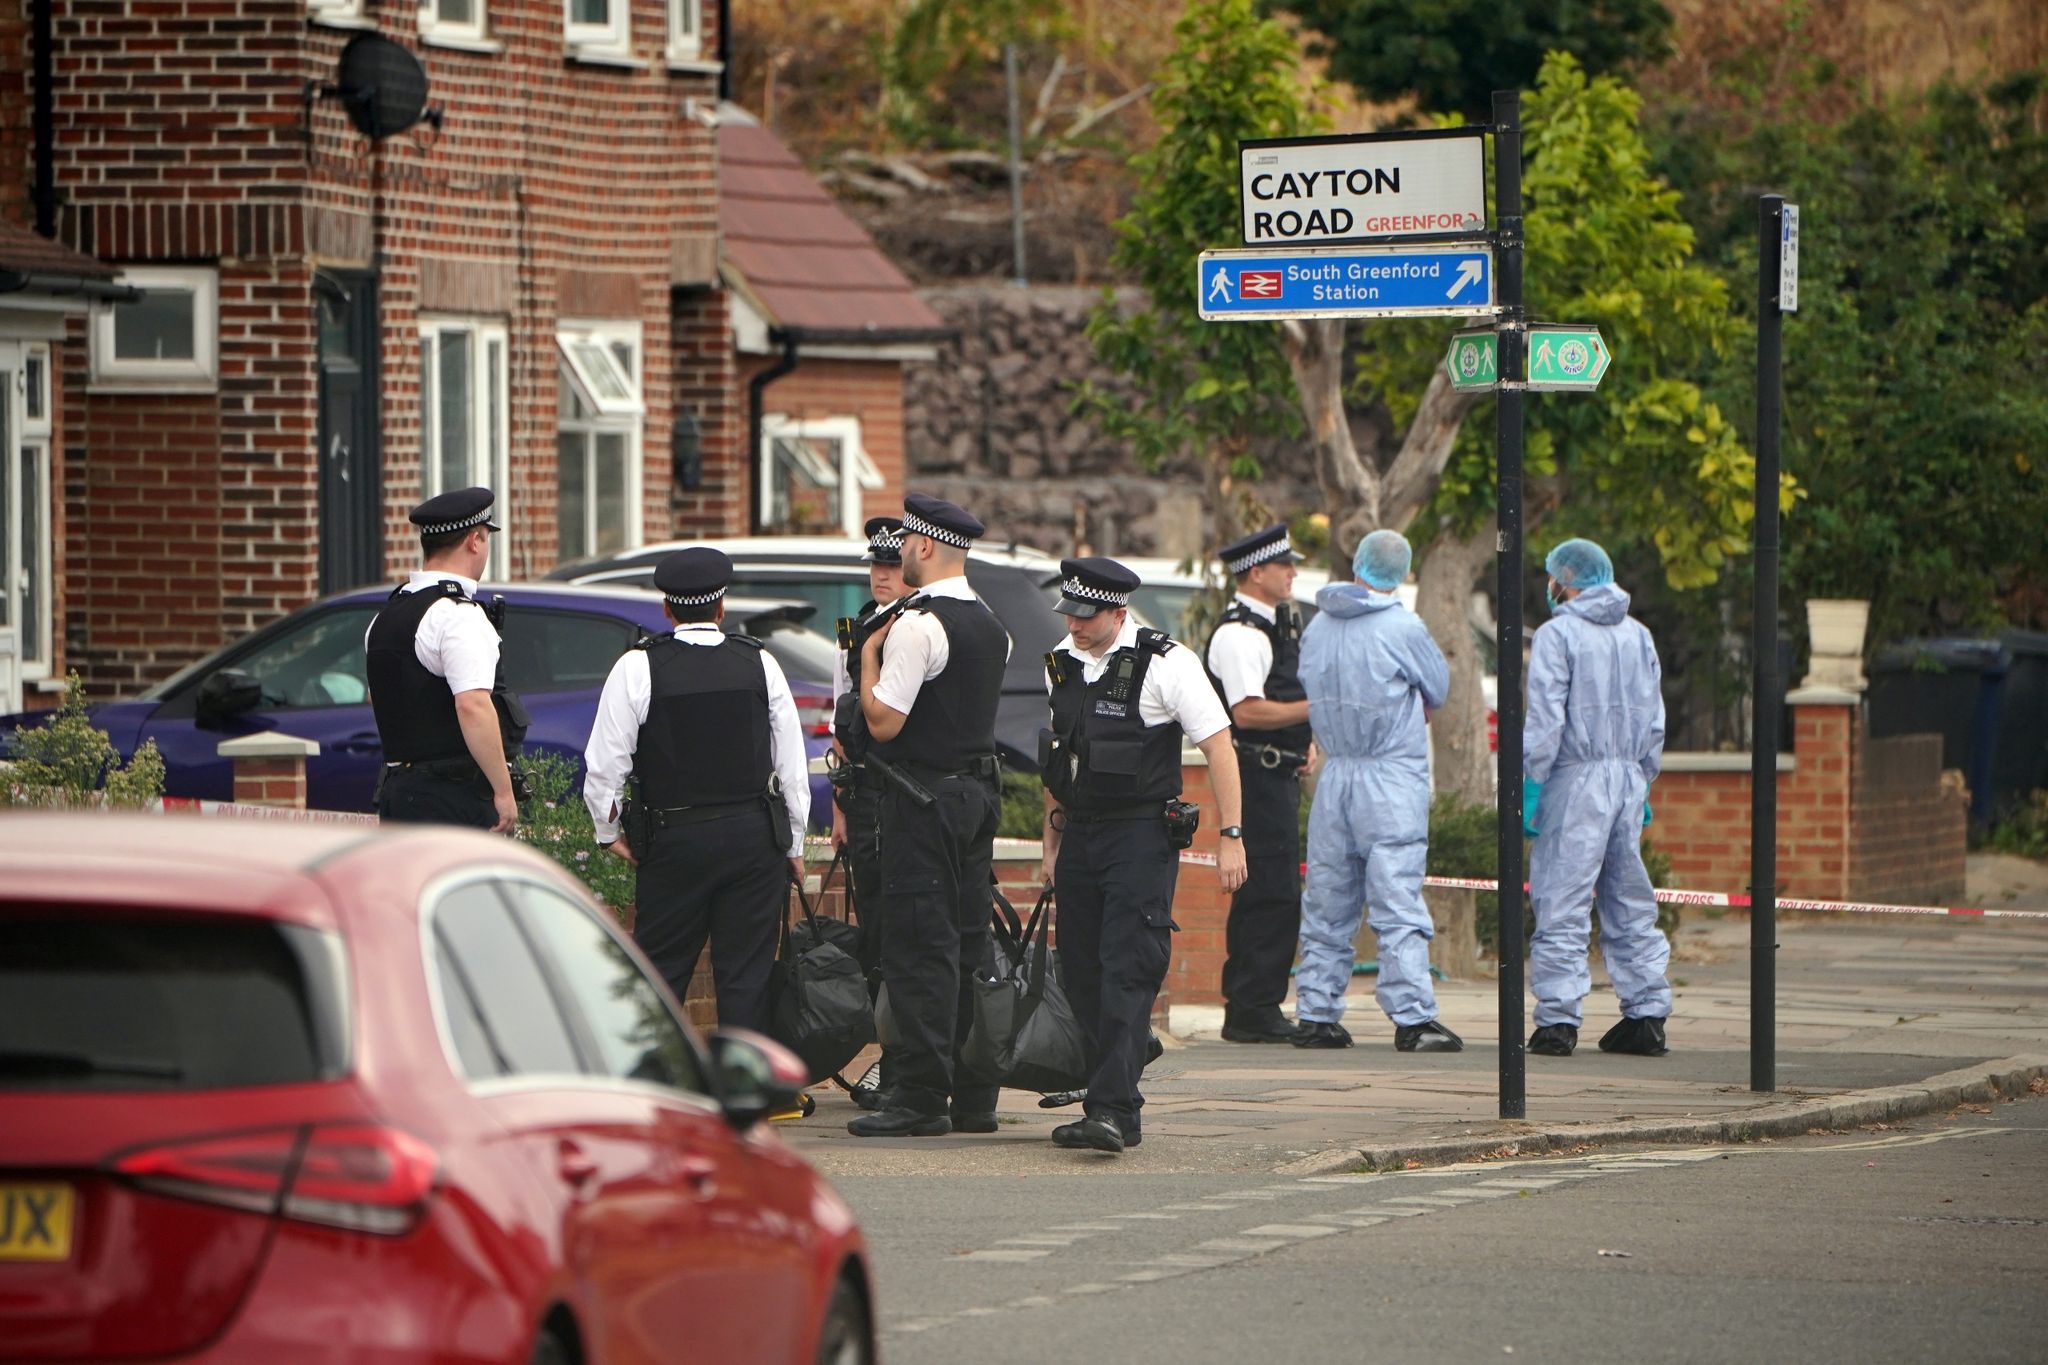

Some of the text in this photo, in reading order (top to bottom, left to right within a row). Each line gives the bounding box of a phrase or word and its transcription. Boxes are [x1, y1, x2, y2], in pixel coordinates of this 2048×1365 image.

[1251, 167, 1400, 200] CAYTON
[1254, 208, 1354, 238] ROAD
[1288, 262, 1440, 281] South Greenford
[1313, 284, 1379, 300] Station
[217, 804, 260, 818] POLICE
[1655, 892, 1715, 905] OT CROSS
[1778, 901, 1819, 910] POLICE
